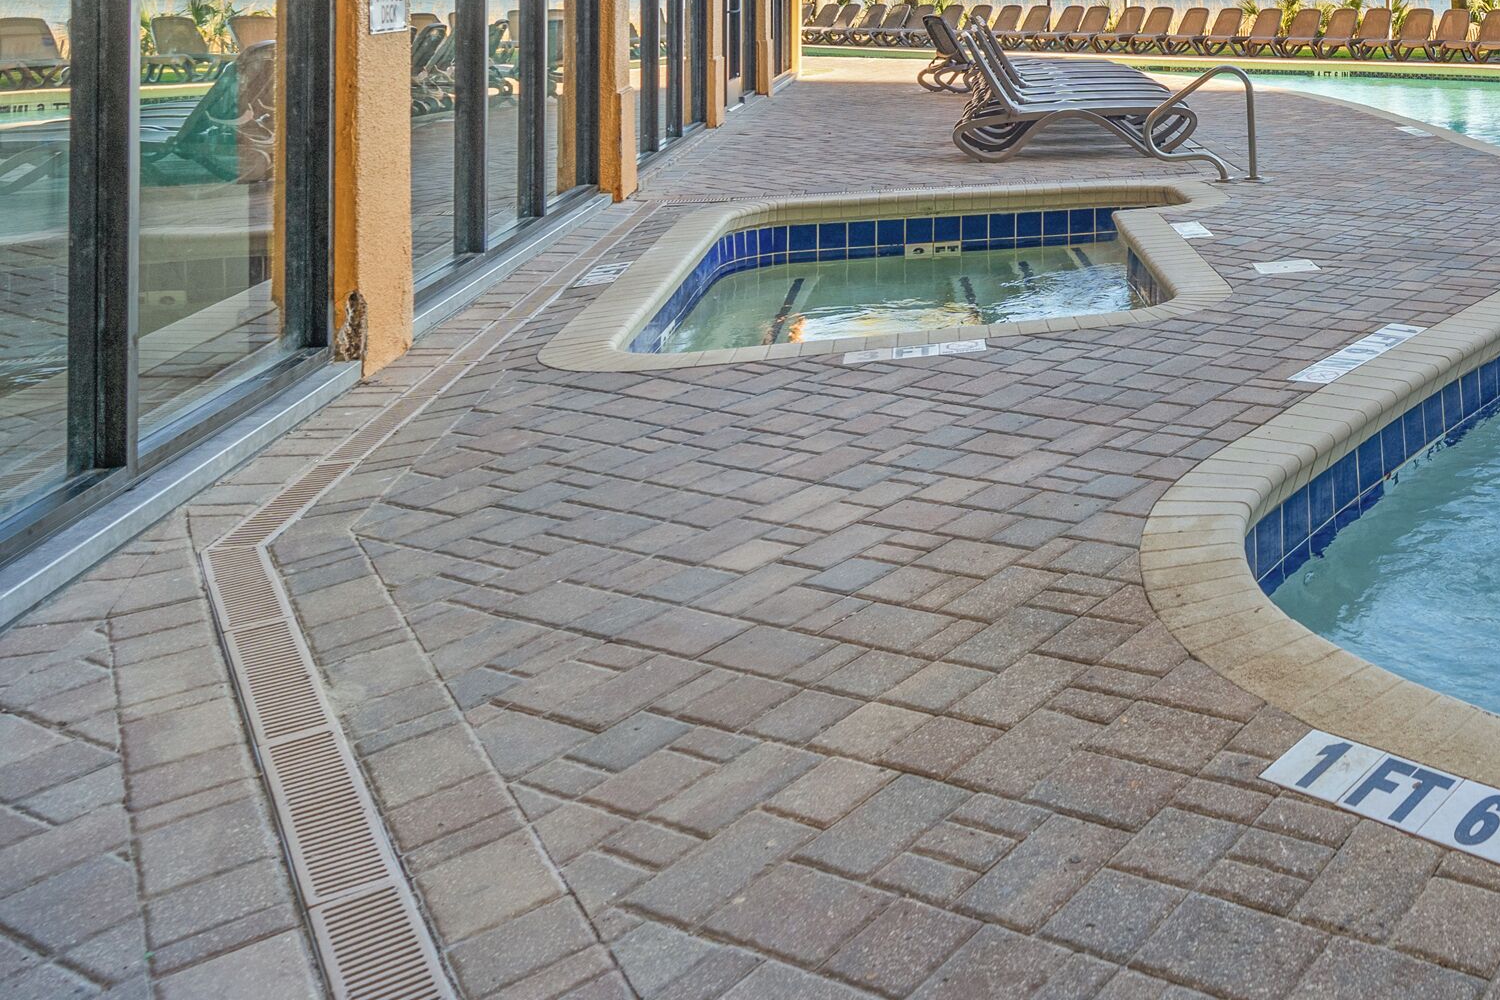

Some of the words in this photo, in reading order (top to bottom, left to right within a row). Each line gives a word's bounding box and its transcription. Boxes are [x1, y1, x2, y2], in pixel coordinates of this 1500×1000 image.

[381, 4, 398, 24] DECK
[1361, 333, 1406, 347] FT
[895, 344, 937, 357] FT
[1295, 741, 1354, 789] 1
[1343, 756, 1455, 823] FT
